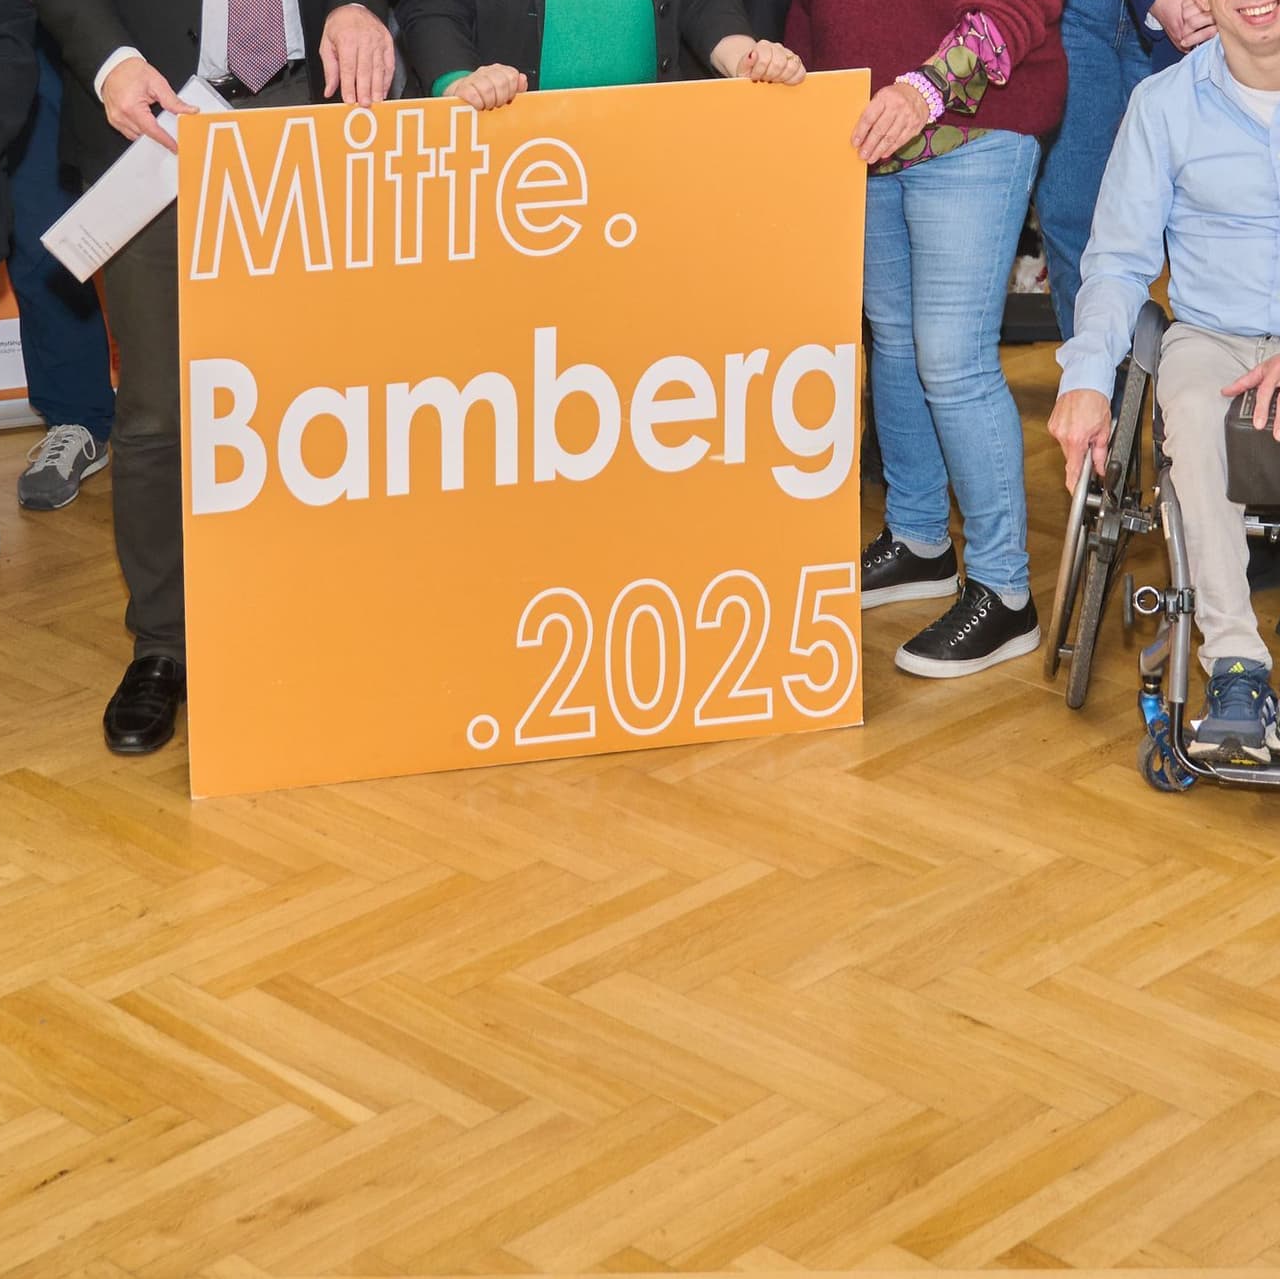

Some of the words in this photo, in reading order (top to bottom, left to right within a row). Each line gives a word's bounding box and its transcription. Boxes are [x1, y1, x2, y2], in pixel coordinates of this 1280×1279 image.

[189, 106, 638, 281] Mitte.
[189, 325, 857, 516] Bamberg
[466, 561, 858, 751] .2025
